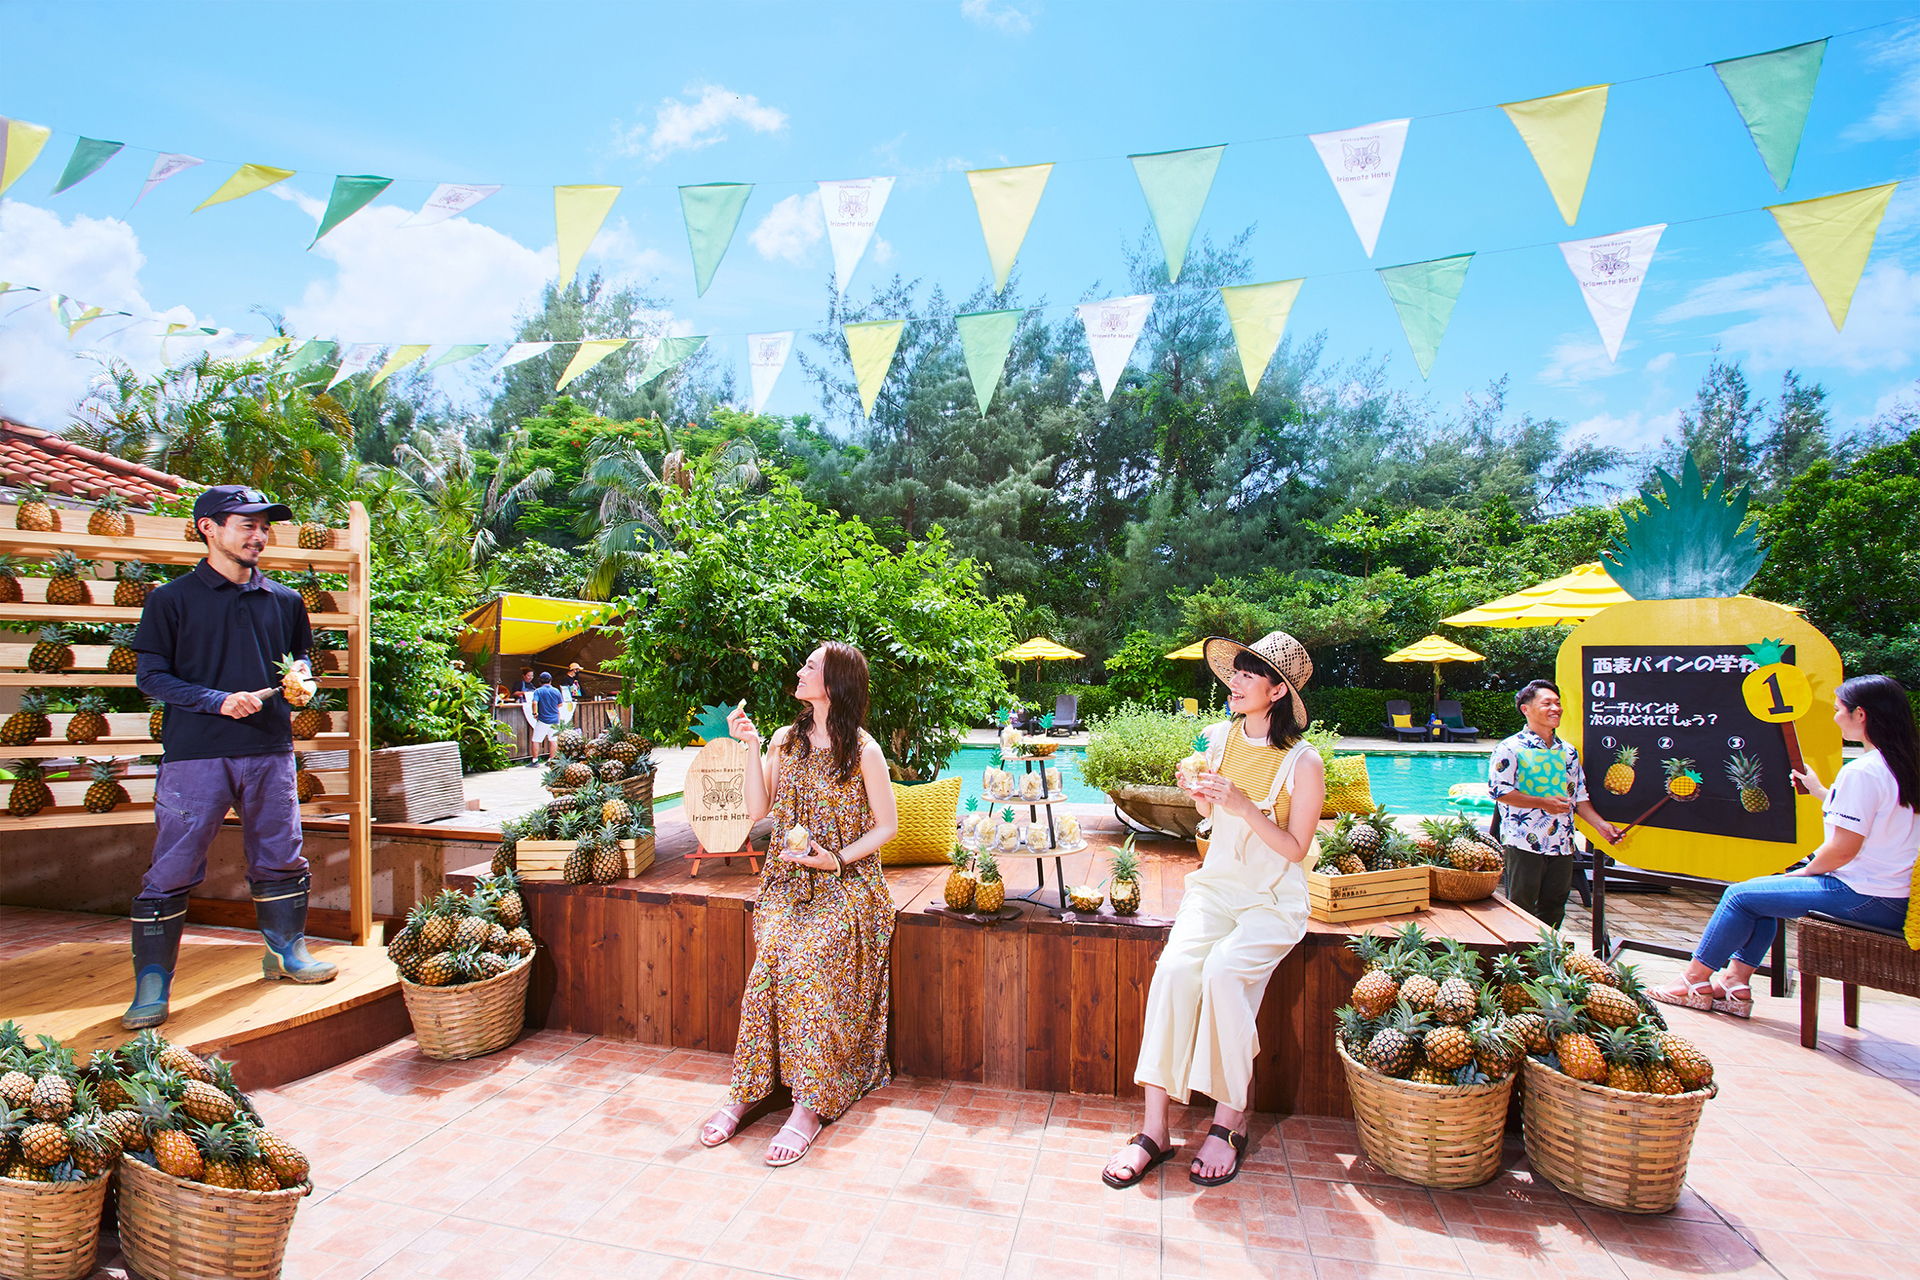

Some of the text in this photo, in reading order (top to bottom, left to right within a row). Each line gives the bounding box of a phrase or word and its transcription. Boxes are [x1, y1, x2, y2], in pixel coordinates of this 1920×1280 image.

[1337, 171, 1391, 182] Iriomote Hotel
[1582, 275, 1639, 287] Iriomote Hotel
[1591, 680, 1616, 698] Q1
[1762, 672, 1794, 715] 1
[1591, 701, 1680, 714] ピーチパインは
